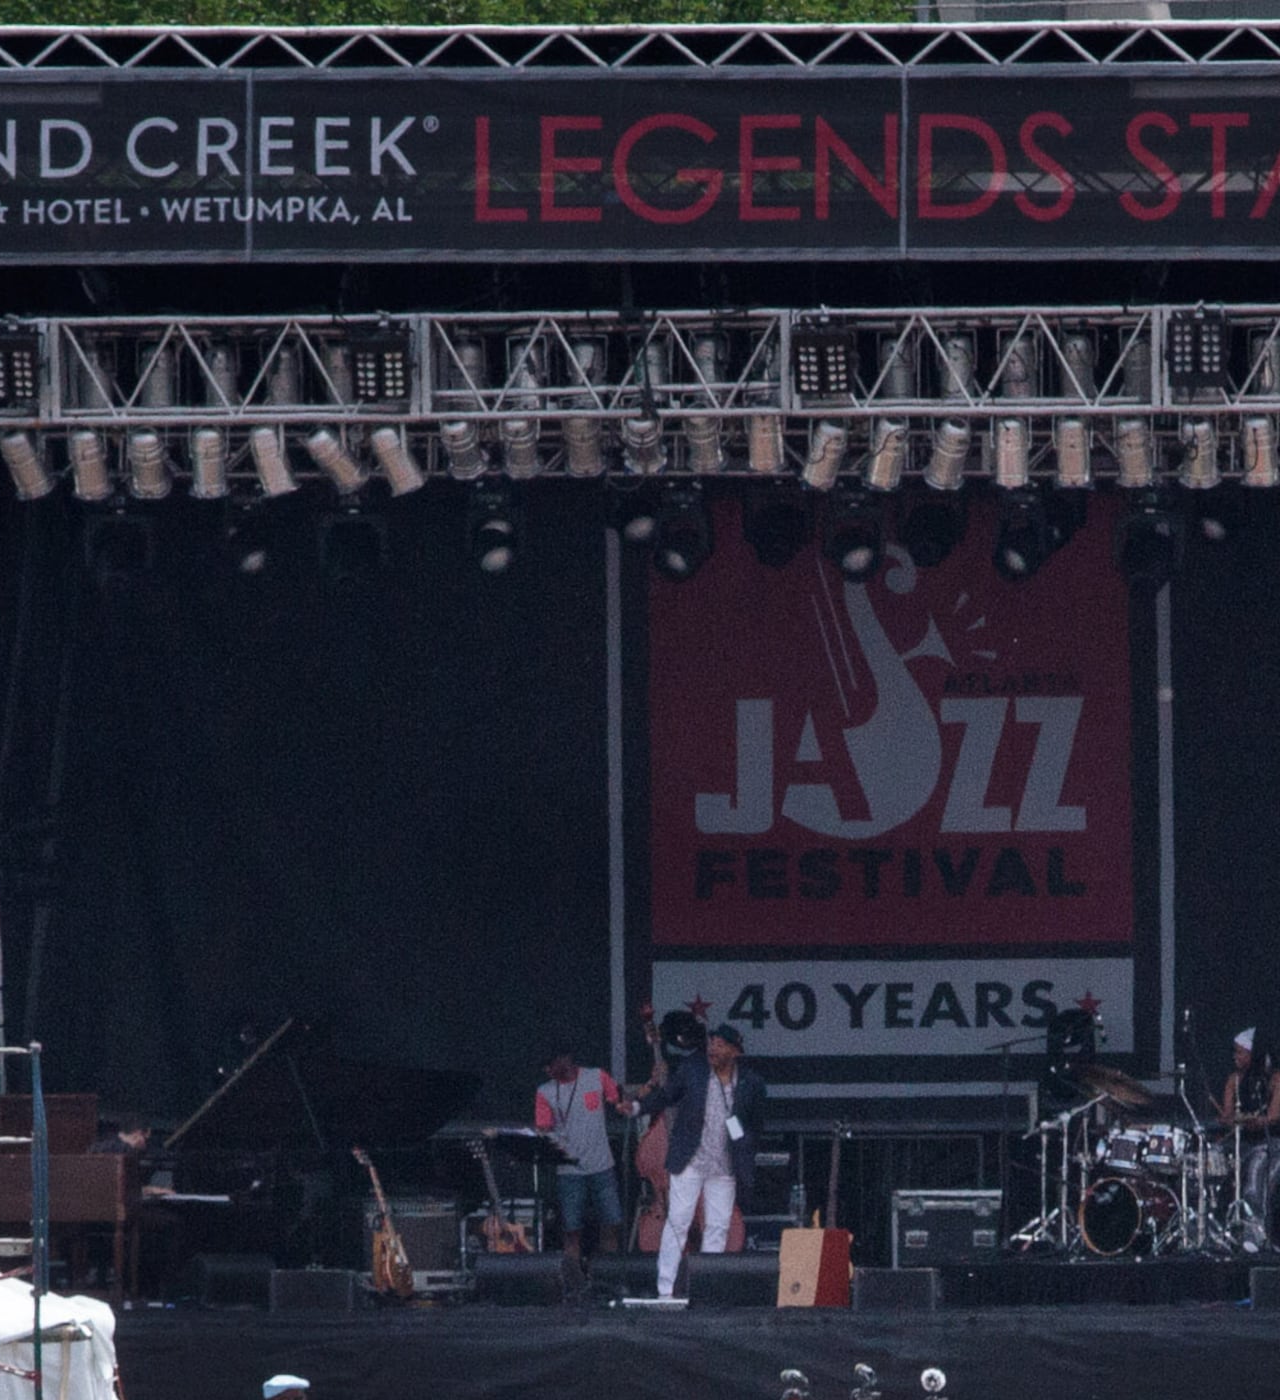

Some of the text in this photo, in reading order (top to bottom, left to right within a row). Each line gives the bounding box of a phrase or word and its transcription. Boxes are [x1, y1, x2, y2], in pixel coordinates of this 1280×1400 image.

[474, 113, 1075, 223] LEGENDS
[23, 198, 131, 227] HOTEL
[163, 195, 362, 229] WETUMPKA,
[371, 195, 413, 224] AL
[694, 696, 1089, 840] JAZZ
[693, 846, 1088, 901] FESTIVAL
[727, 979, 1061, 1030] 40 YEARS
